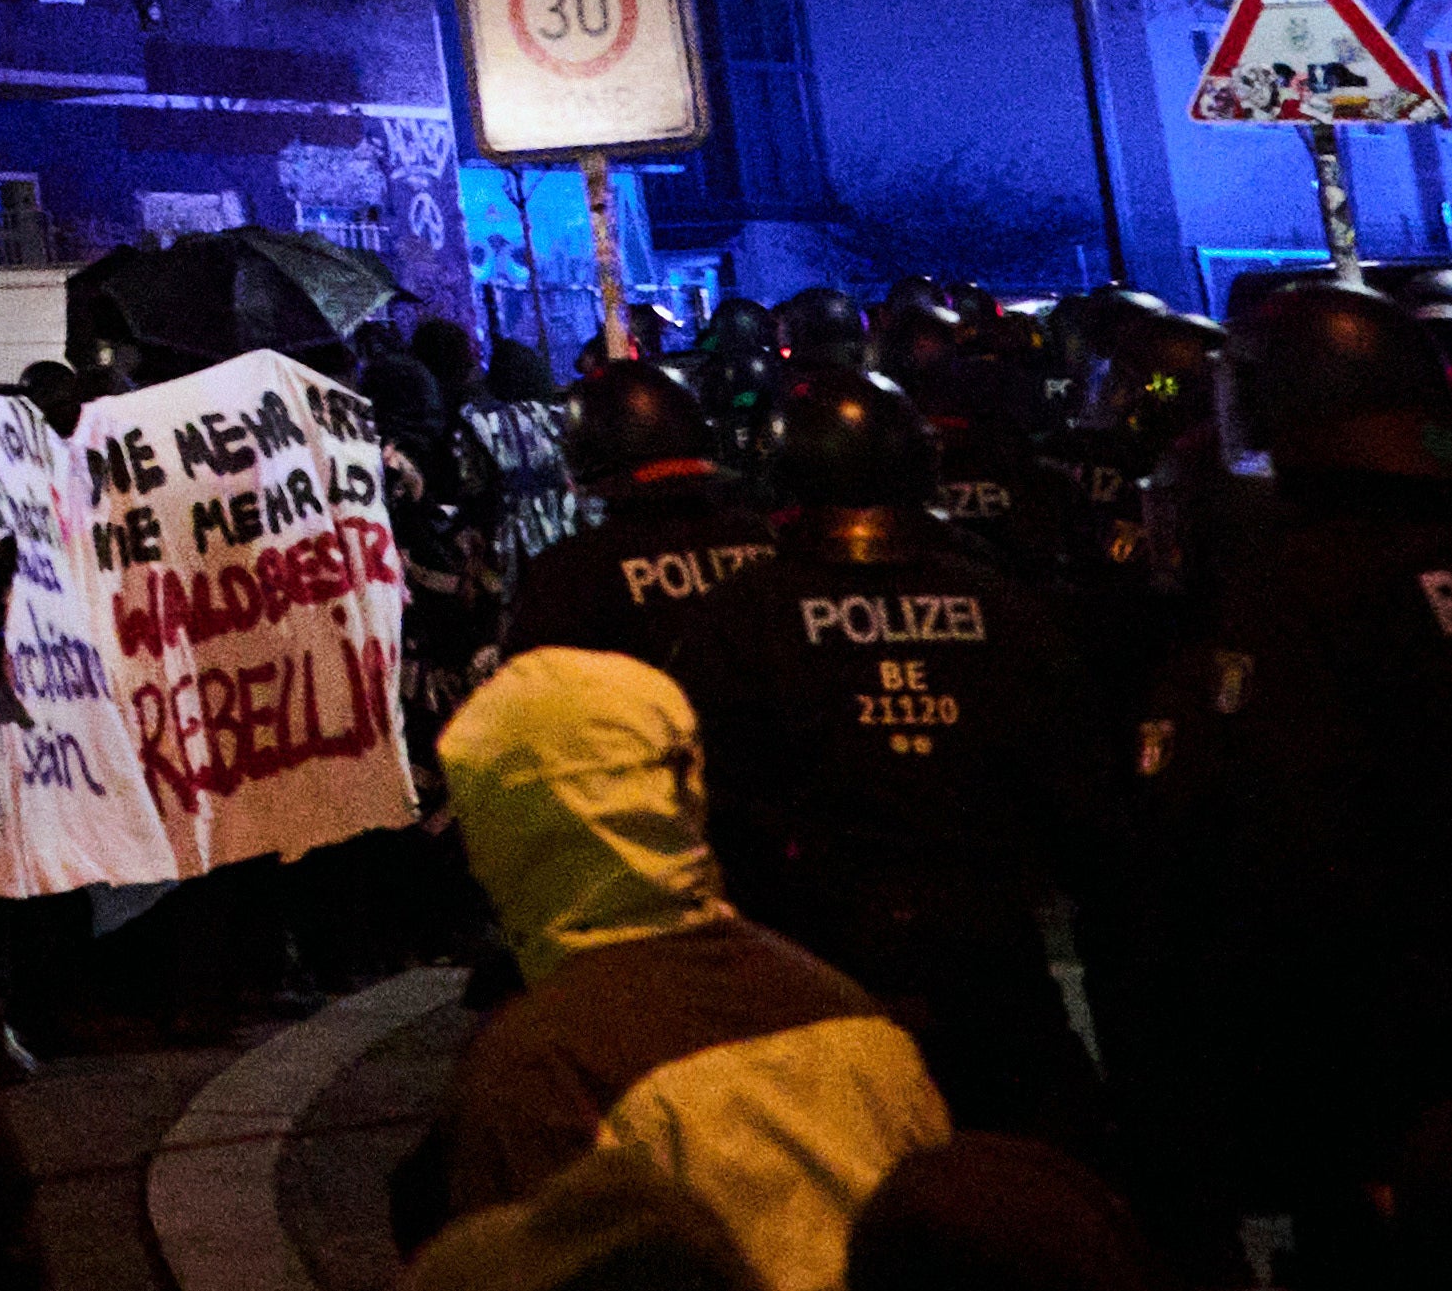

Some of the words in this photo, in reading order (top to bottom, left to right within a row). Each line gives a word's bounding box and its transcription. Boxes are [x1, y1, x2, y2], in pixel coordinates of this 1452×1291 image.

[191, 466, 324, 554] MEHR
[800, 595, 985, 644] POLIZEI
[879, 659, 929, 692] BE
